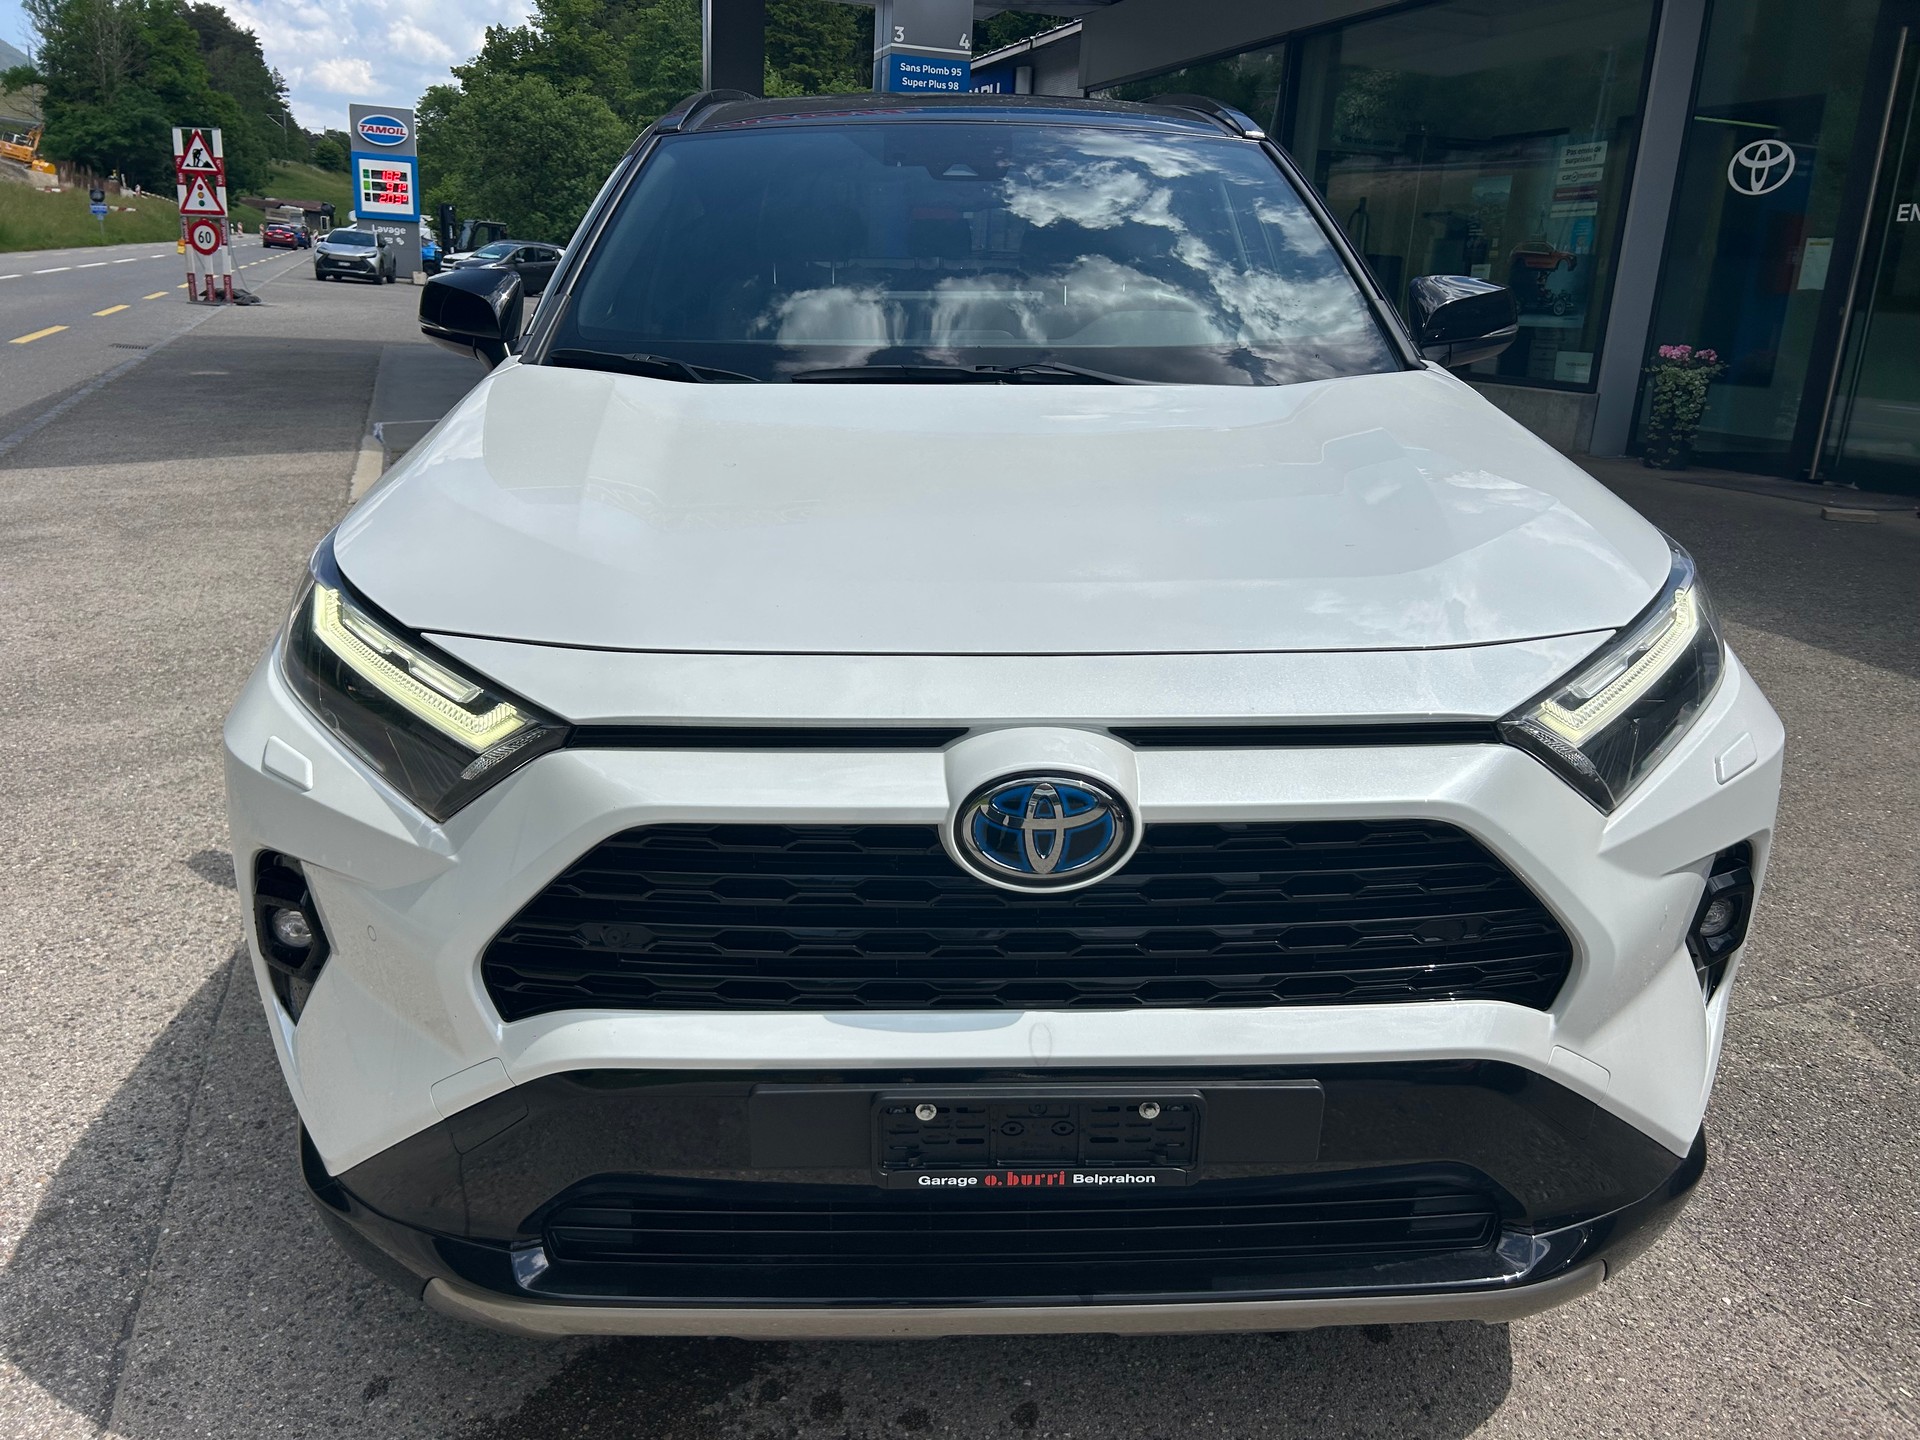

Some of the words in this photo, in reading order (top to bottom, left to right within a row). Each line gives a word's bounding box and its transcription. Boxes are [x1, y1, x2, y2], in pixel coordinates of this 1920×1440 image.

[893, 26, 905, 42] 3
[959, 33, 970, 49] 4
[900, 62, 921, 73] Sans
[922, 64, 950, 75] Plomb
[951, 67, 962, 77] 95
[902, 77, 927, 89] Super
[928, 79, 947, 89] Plus
[948, 81, 959, 91] 98
[359, 124, 407, 136] TAMOIL
[371, 224, 407, 236] Lavage
[198, 231, 212, 244] 60
[918, 1175, 978, 1187] Garage
[1073, 1173, 1156, 1185] Belprahon
